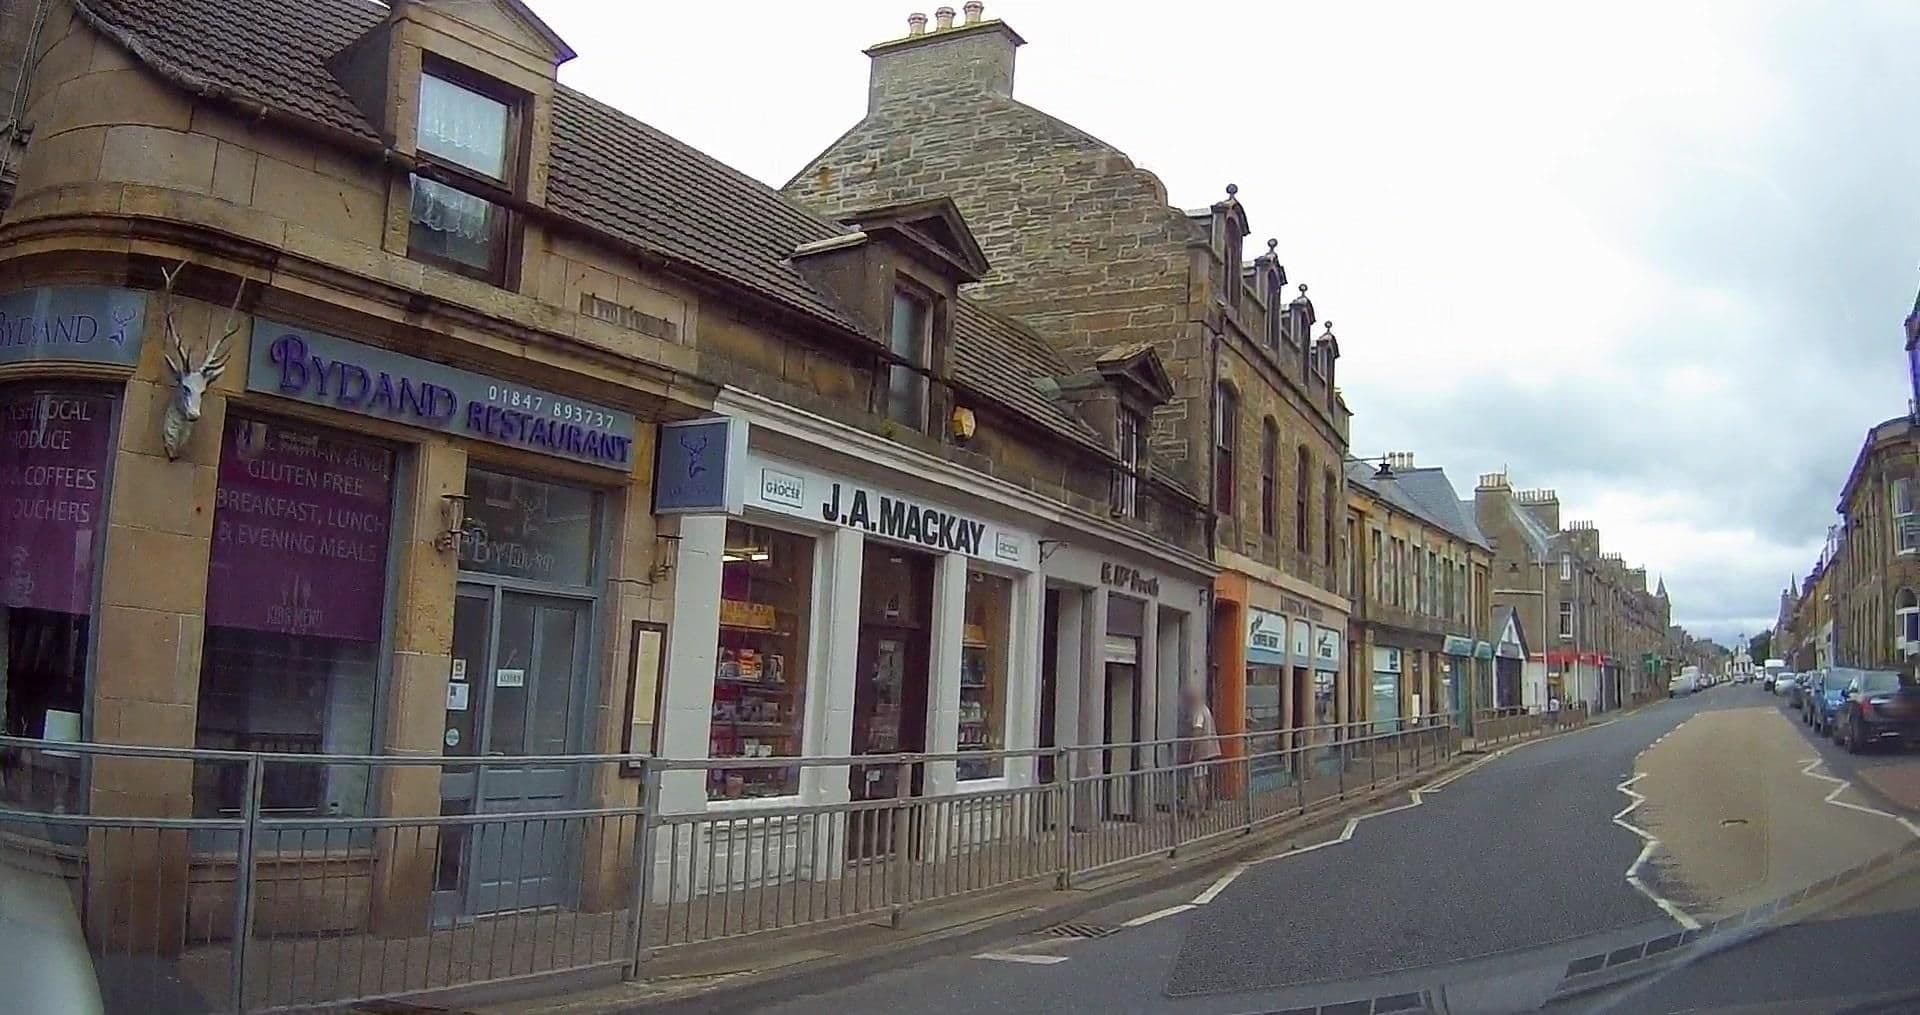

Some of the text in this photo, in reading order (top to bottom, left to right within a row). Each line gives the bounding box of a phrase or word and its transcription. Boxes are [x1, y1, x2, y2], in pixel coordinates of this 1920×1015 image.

[270, 334, 459, 419] BYDAND
[489, 386, 615, 430] 01847 893737
[467, 399, 633, 464] RESTAURANT
[25, 465, 97, 489] COFFEES
[248, 459, 364, 497] GLUTEN FREE
[9, 499, 90, 523] OUCHERS
[328, 508, 386, 534] LUNCH
[238, 524, 316, 555] EVENING
[320, 537, 377, 563] MEALS
